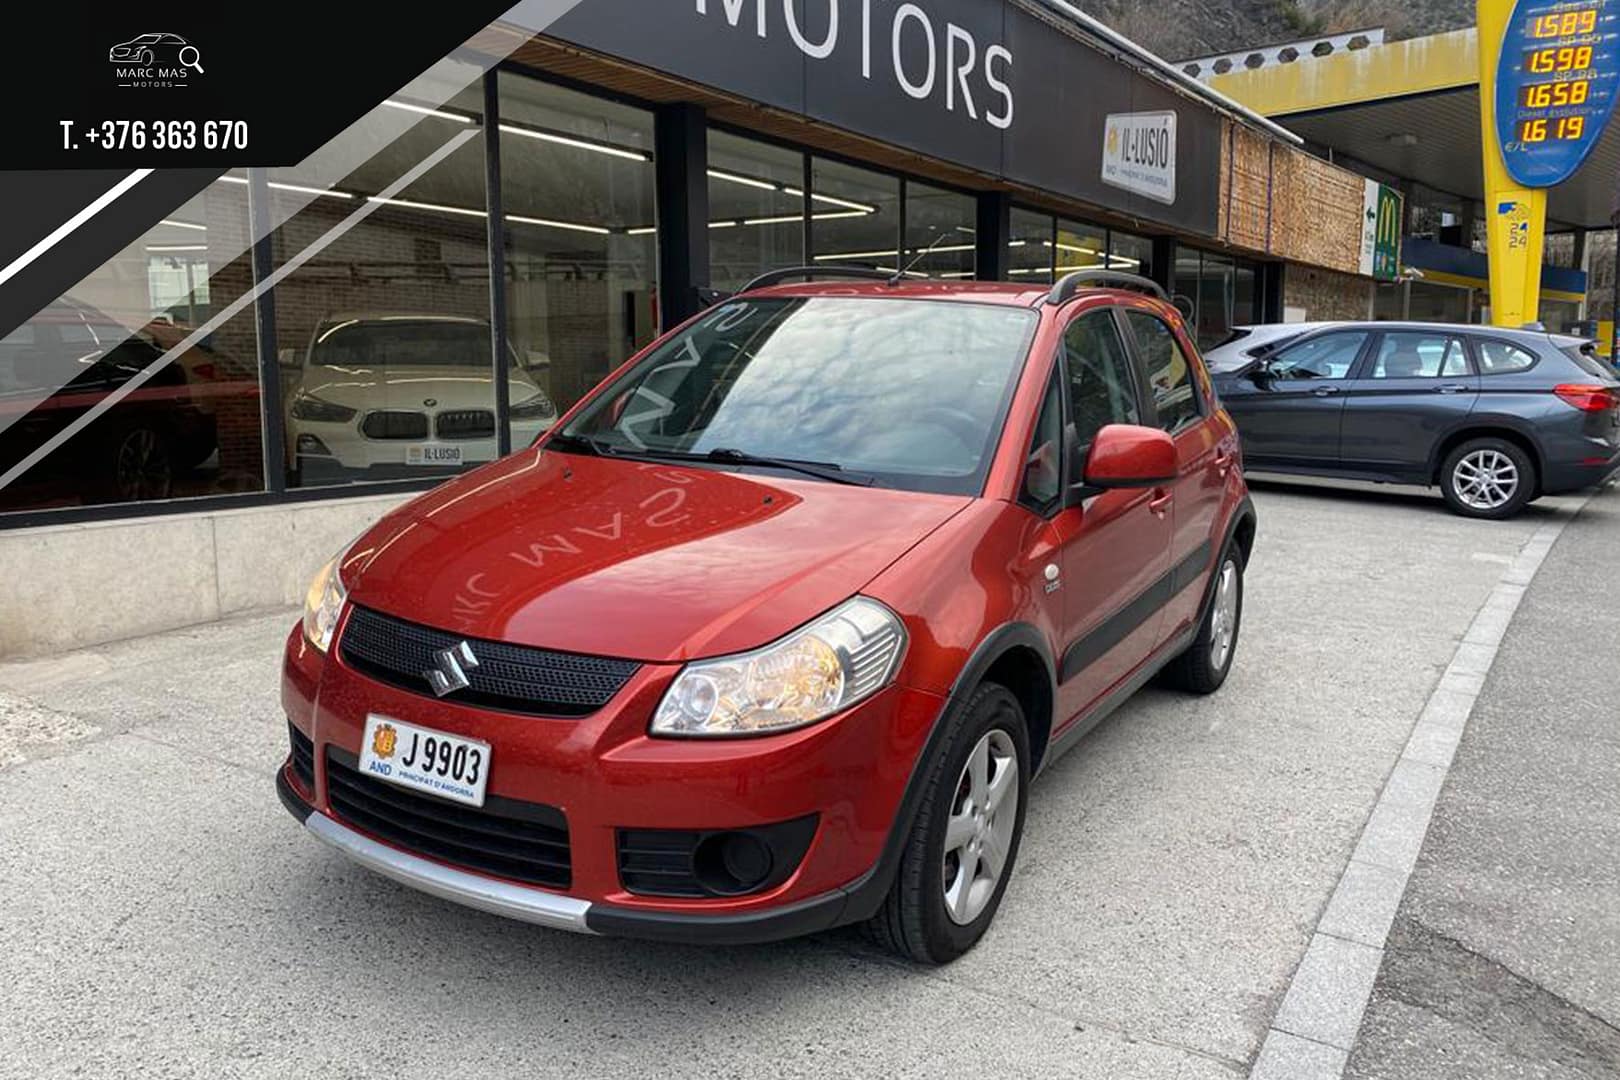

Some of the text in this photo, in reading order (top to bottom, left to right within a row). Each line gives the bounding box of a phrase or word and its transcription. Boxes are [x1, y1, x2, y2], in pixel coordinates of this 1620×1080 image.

[369, 760, 392, 776] AND
[402, 733, 481, 785] J 9903
